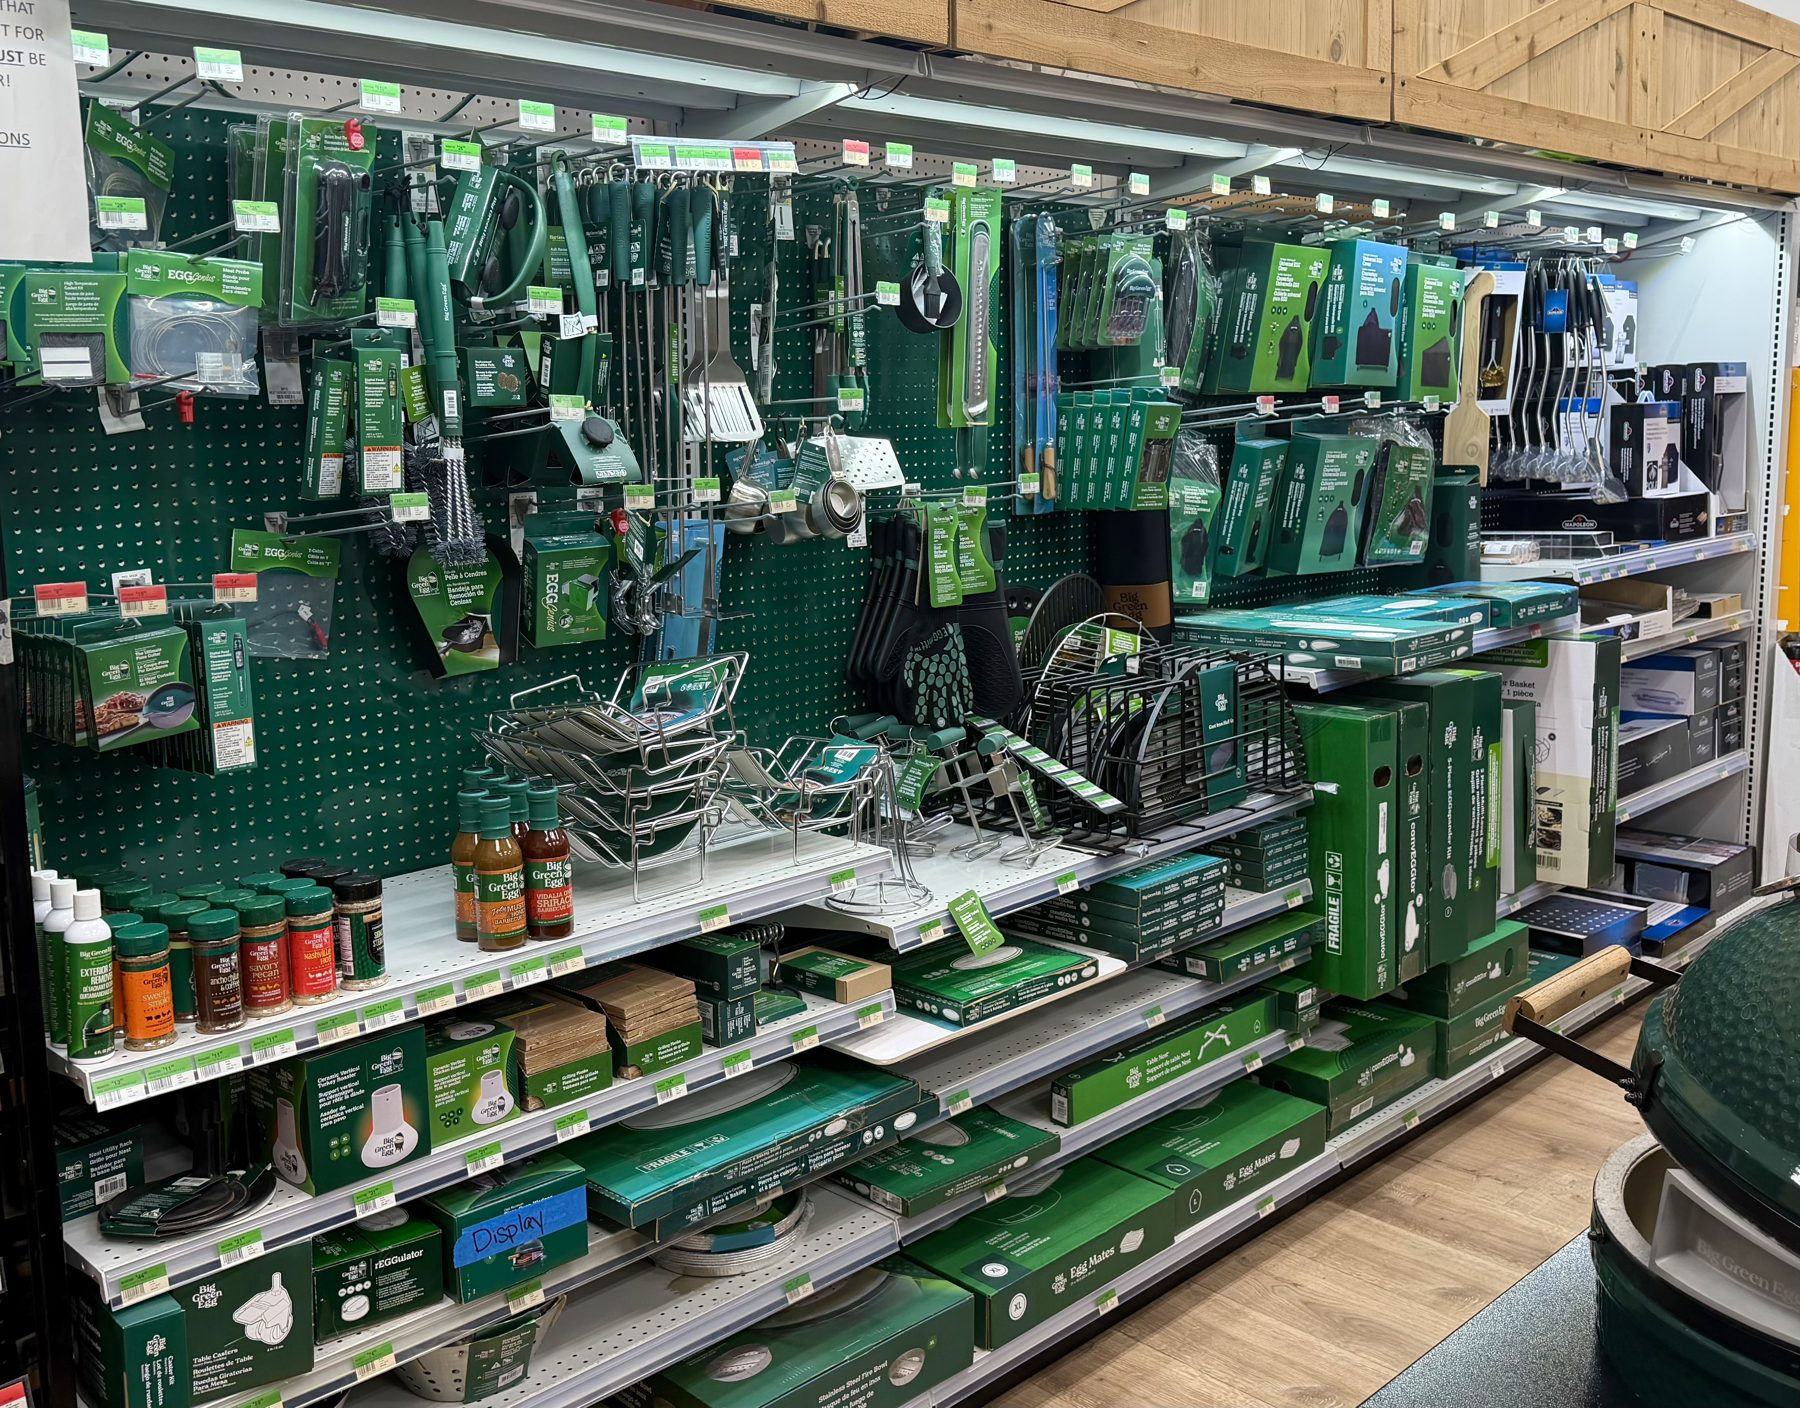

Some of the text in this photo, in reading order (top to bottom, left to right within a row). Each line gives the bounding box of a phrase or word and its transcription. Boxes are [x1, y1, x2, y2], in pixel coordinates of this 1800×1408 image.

[0, 2, 35, 15] THAT
[15, 27, 45, 41] FOR
[29, 51, 46, 66] BE
[168, 269, 193, 280] EGG
[264, 548, 285, 557] EGG
[464, 570, 487, 578] Cendres
[411, 581, 430, 589] Green
[447, 585, 471, 594] Bandeja
[546, 573, 558, 604] EGG
[1119, 592, 1139, 603] Big
[1112, 601, 1149, 612] Green
[101, 669, 121, 677] Green
[1509, 679, 1535, 689] Basket
[1512, 689, 1534, 698] pièce
[221, 718, 249, 728] WARNING
[1409, 821, 1417, 895] convEGGtor
[547, 861, 563, 871] Big
[503, 872, 519, 883] Big
[532, 869, 563, 880] Green
[488, 881, 519, 893] Green
[544, 878, 564, 889] Egg
[501, 889, 520, 901] Egg
[536, 892, 563, 900] VIDALIA
[1328, 896, 1341, 951] FRAGILE
[1379, 903, 1387, 959] convEGGtor
[304, 938, 324, 946] Green
[249, 950, 269, 958] Green
[256, 954, 269, 962] Egg
[80, 965, 108, 978] EXTERIOR
[211, 962, 231, 970] Green
[249, 961, 279, 972] savory
[252, 969, 280, 980] pecan
[143, 977, 163, 985] Green
[210, 975, 228, 986] ancho
[1475, 1009, 1500, 1027] Big Green
[380, 1053, 392, 1062] Big
[476, 1054, 492, 1062] Green
[1371, 1052, 1399, 1073] convEGGtor
[371, 1060, 392, 1071] Green
[379, 1065, 393, 1074] Egg
[1129, 1066, 1139, 1076] Big
[317, 1065, 360, 1083] Ceramic Vertical
[318, 1078, 337, 1089] Turkey
[318, 1080, 360, 1098] Support vertical
[319, 1100, 332, 1109] pour
[345, 1103, 365, 1114] vertical
[480, 1105, 497, 1115] Green
[320, 1106, 338, 1118] Asador
[486, 1110, 498, 1118] Egg
[320, 1115, 347, 1129] para pavo
[383, 1137, 394, 1145] Big
[119, 1147, 131, 1155] Nest
[374, 1143, 395, 1154] Green
[381, 1149, 395, 1157] Egg
[642, 1149, 692, 1171] FRAGILE
[1239, 1151, 1277, 1179] Egg Mates
[730, 1187, 747, 1200] Baking
[712, 1203, 727, 1215] Stone
[472, 1210, 544, 1254] Display
[374, 1249, 424, 1270] rEGGulator
[1070, 1246, 1116, 1279] Egg Mates
[1697, 1237, 1770, 1292] Big Green
[199, 1283, 216, 1294] Big
[192, 1290, 223, 1303] Green
[197, 1298, 218, 1309] Egg
[1013, 1301, 1022, 1311] XL
[159, 1337, 167, 1351] Big
[193, 1348, 239, 1365] Table Casters
[193, 1354, 254, 1376] Roulettes de Table
[193, 1366, 253, 1387] Ruedas Giratorias
[818, 1359, 888, 1403] Stainless Steel Fire Bowl
[193, 1379, 228, 1393] Para Mesa
[850, 1375, 882, 1397] feu en inox
[866, 1390, 875, 1399] de
